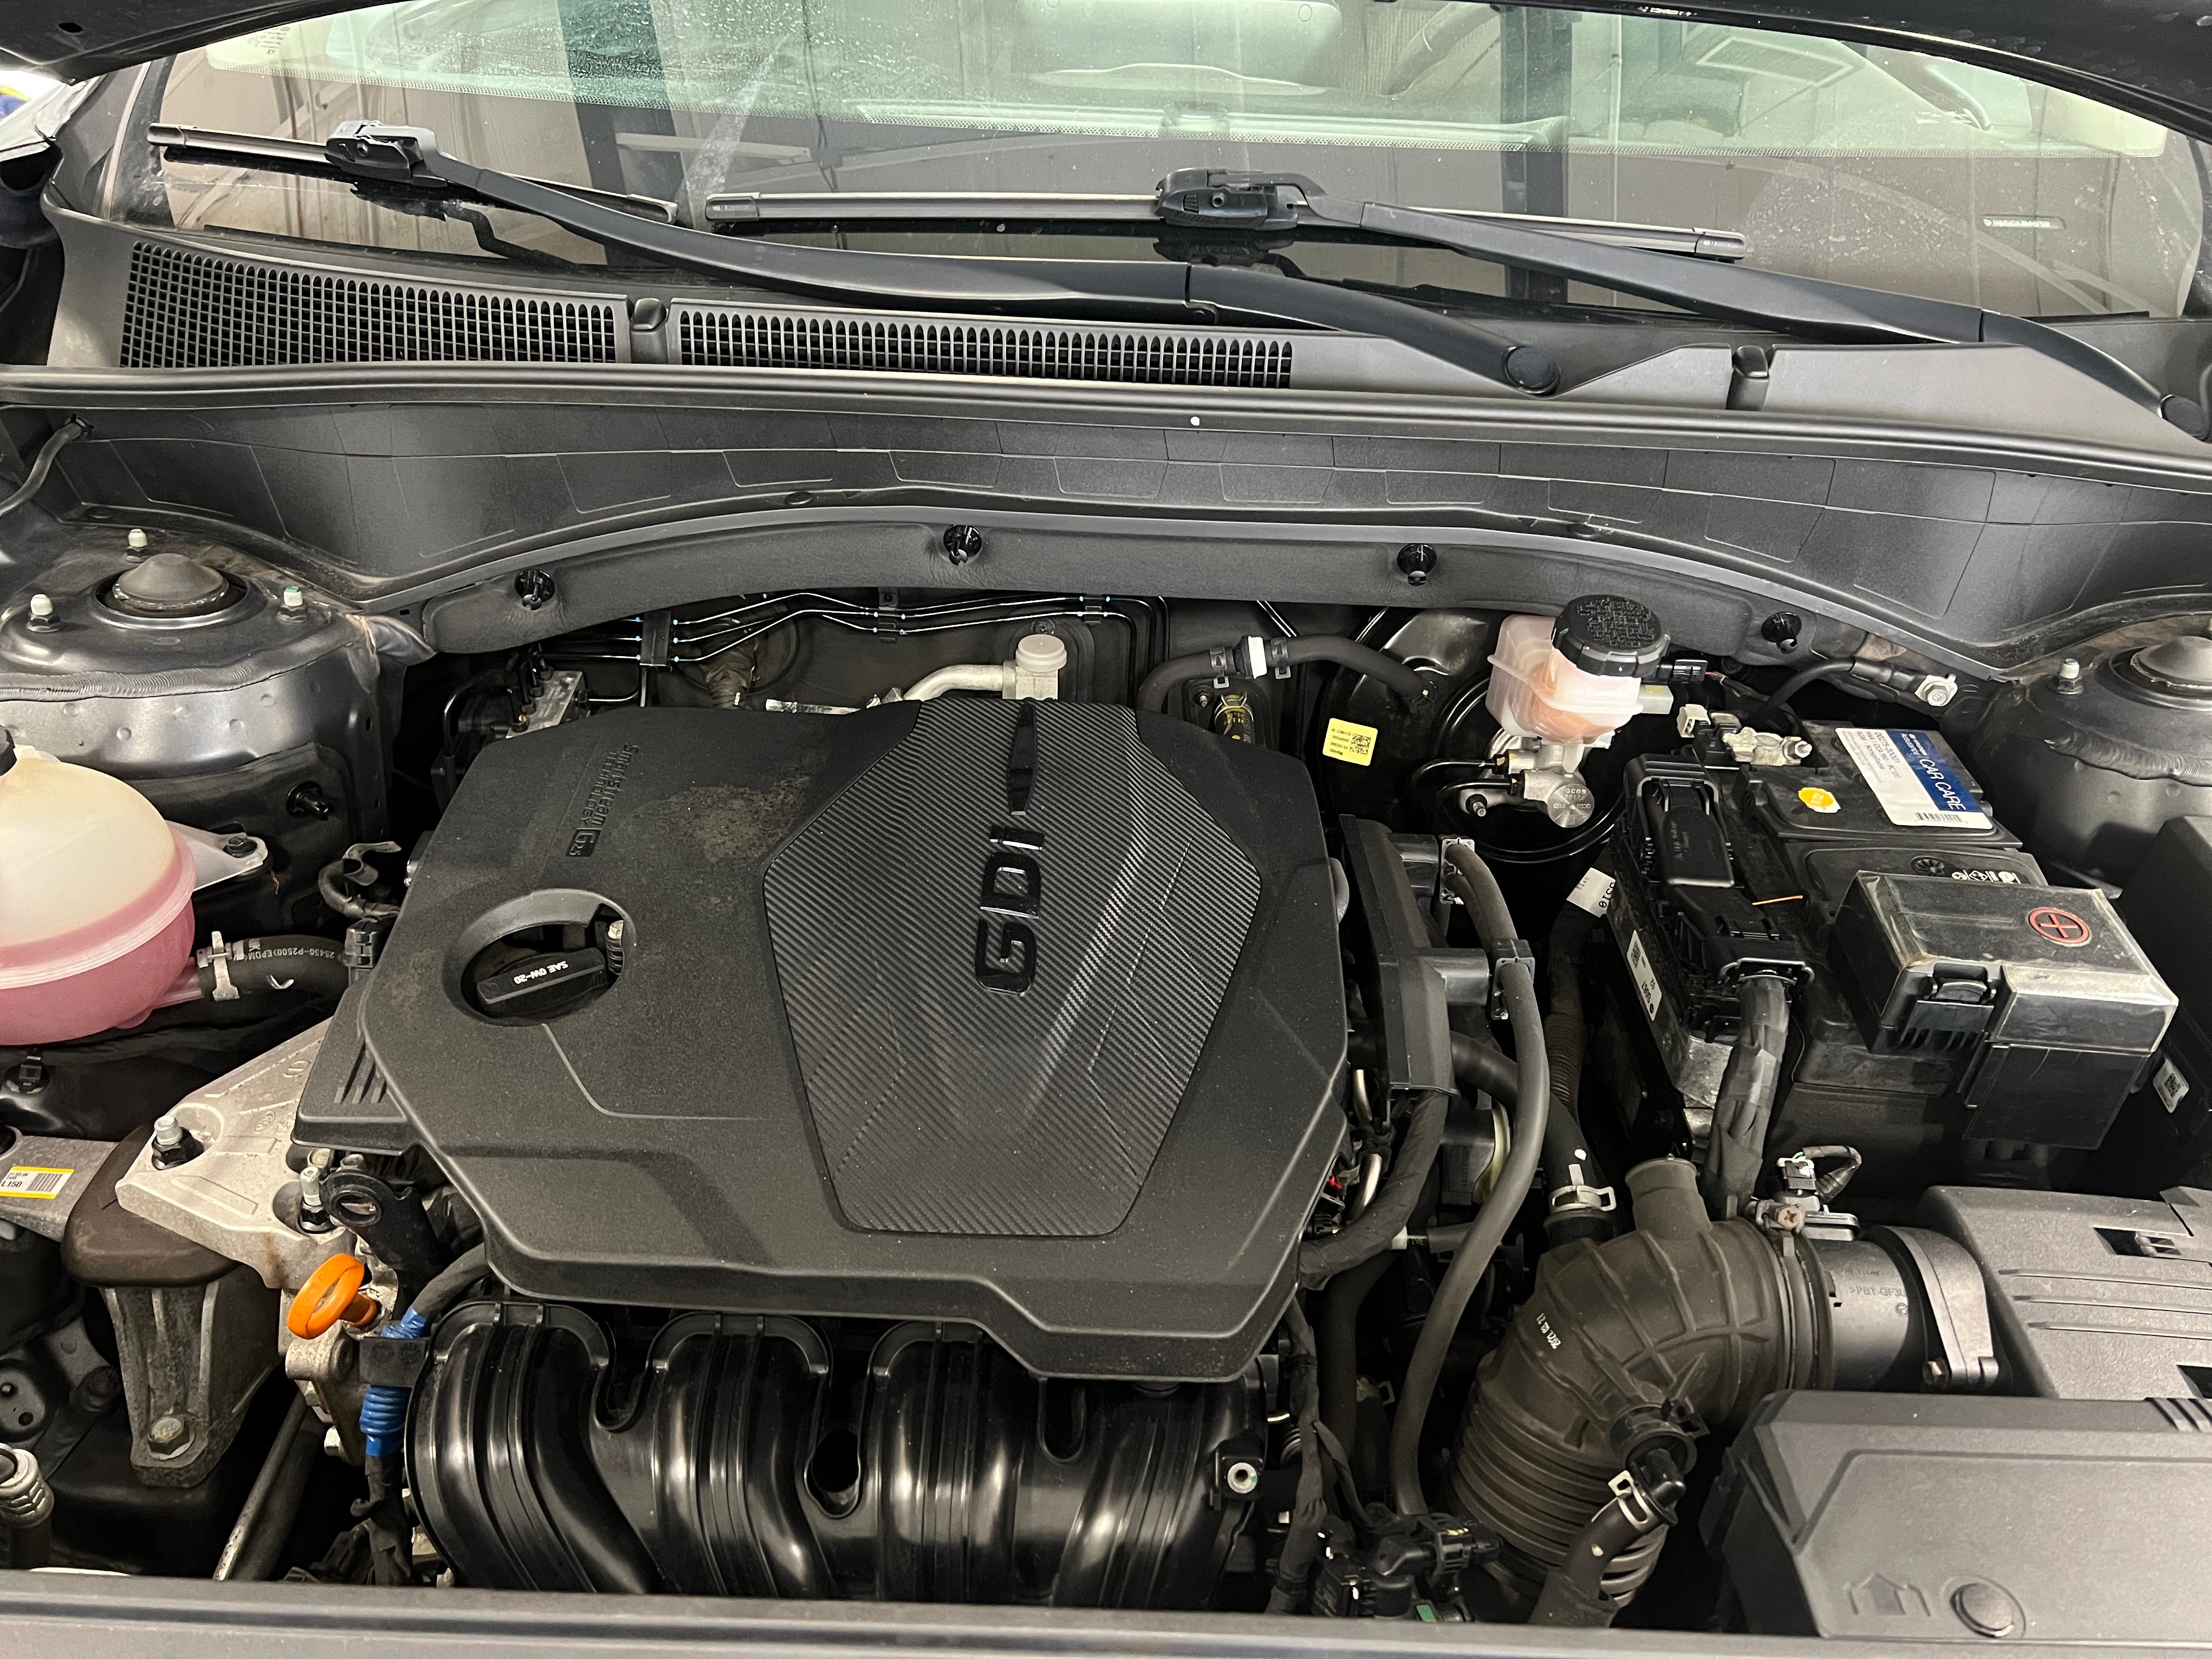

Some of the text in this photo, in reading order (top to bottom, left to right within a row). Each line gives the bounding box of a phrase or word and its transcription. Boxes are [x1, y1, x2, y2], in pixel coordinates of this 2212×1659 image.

[1919, 759, 1944, 780] CAR
[1934, 781, 1967, 811] CARE
[513, 960, 569, 985] SAE 0W-20
